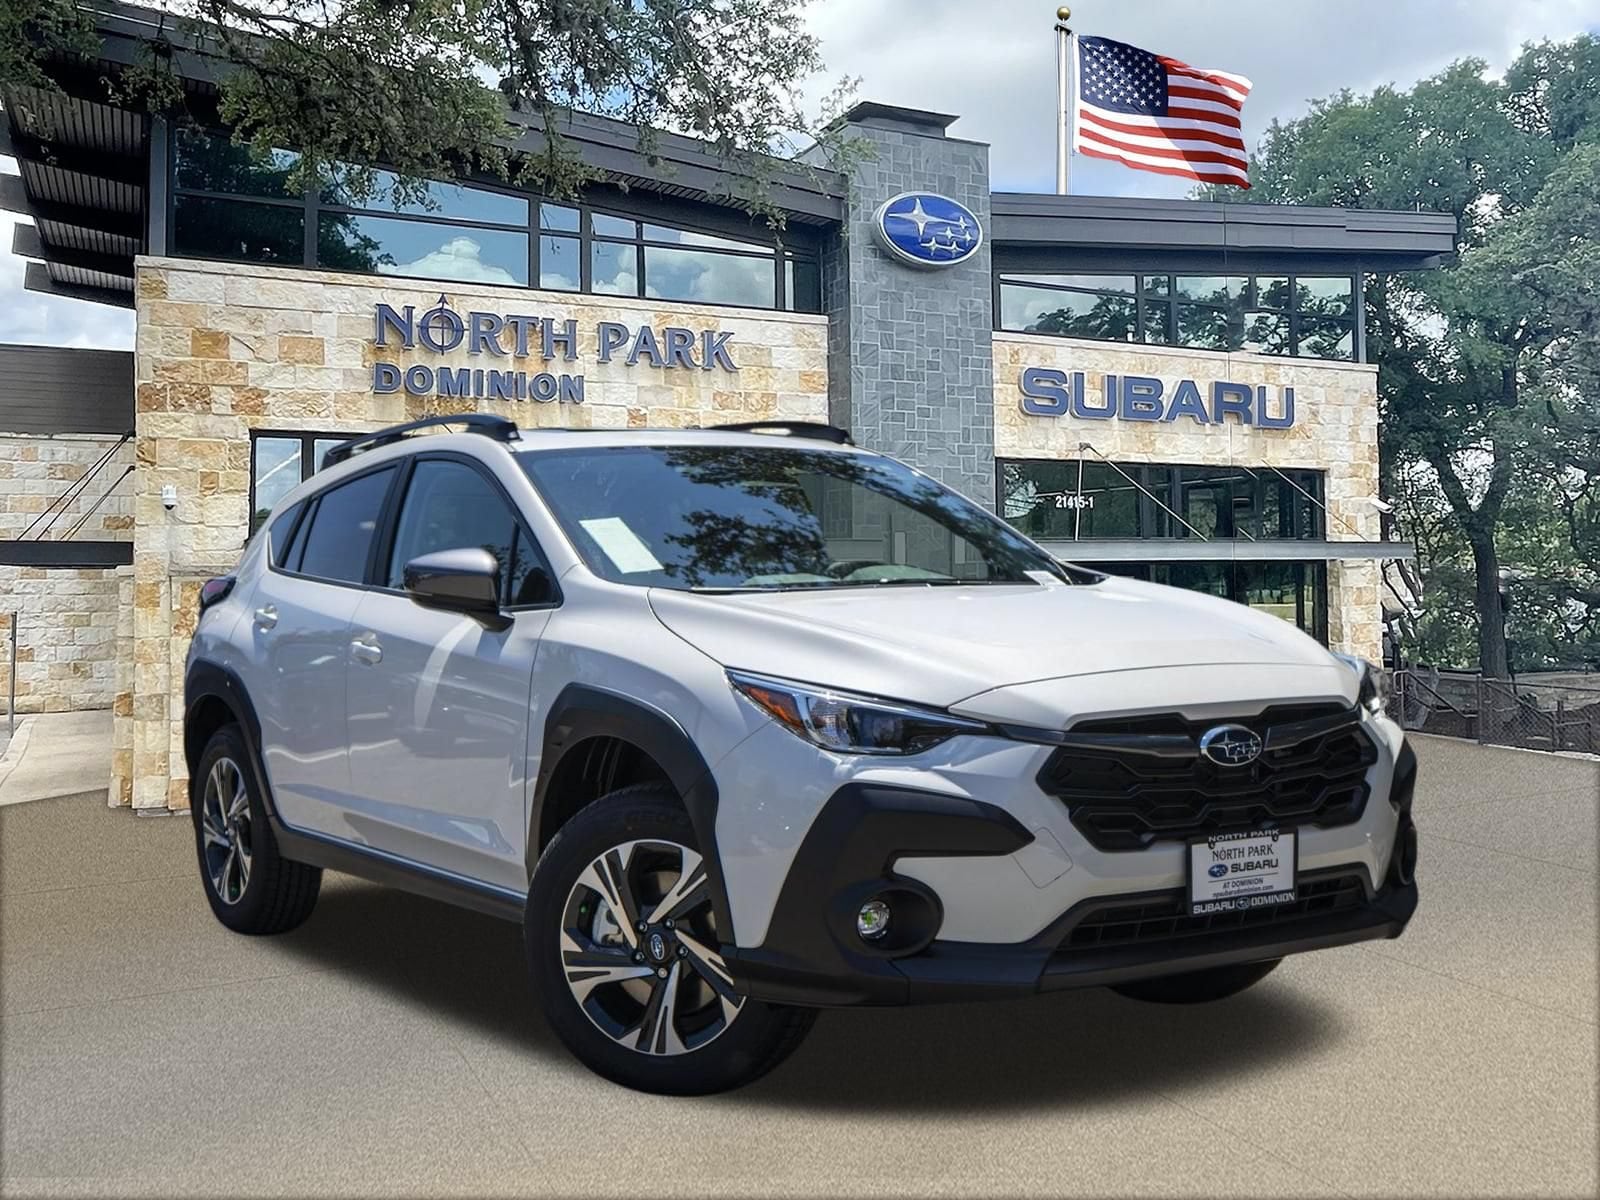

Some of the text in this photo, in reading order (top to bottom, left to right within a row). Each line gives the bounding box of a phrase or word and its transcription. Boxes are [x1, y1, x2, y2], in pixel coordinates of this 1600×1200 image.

[374, 300, 741, 372] NORTH PARK
[373, 362, 585, 405] DOMINION
[1019, 366, 1296, 430] SUBARU
[1055, 495, 1094, 509] 21415-1
[1208, 828, 1279, 842] NORTH PARK
[1212, 844, 1274, 862] NORTH PARK
[1230, 859, 1278, 873] SUBARU
[1222, 877, 1264, 889] AT DOMINION
[1193, 891, 1295, 915] SUBARU DOMINION
